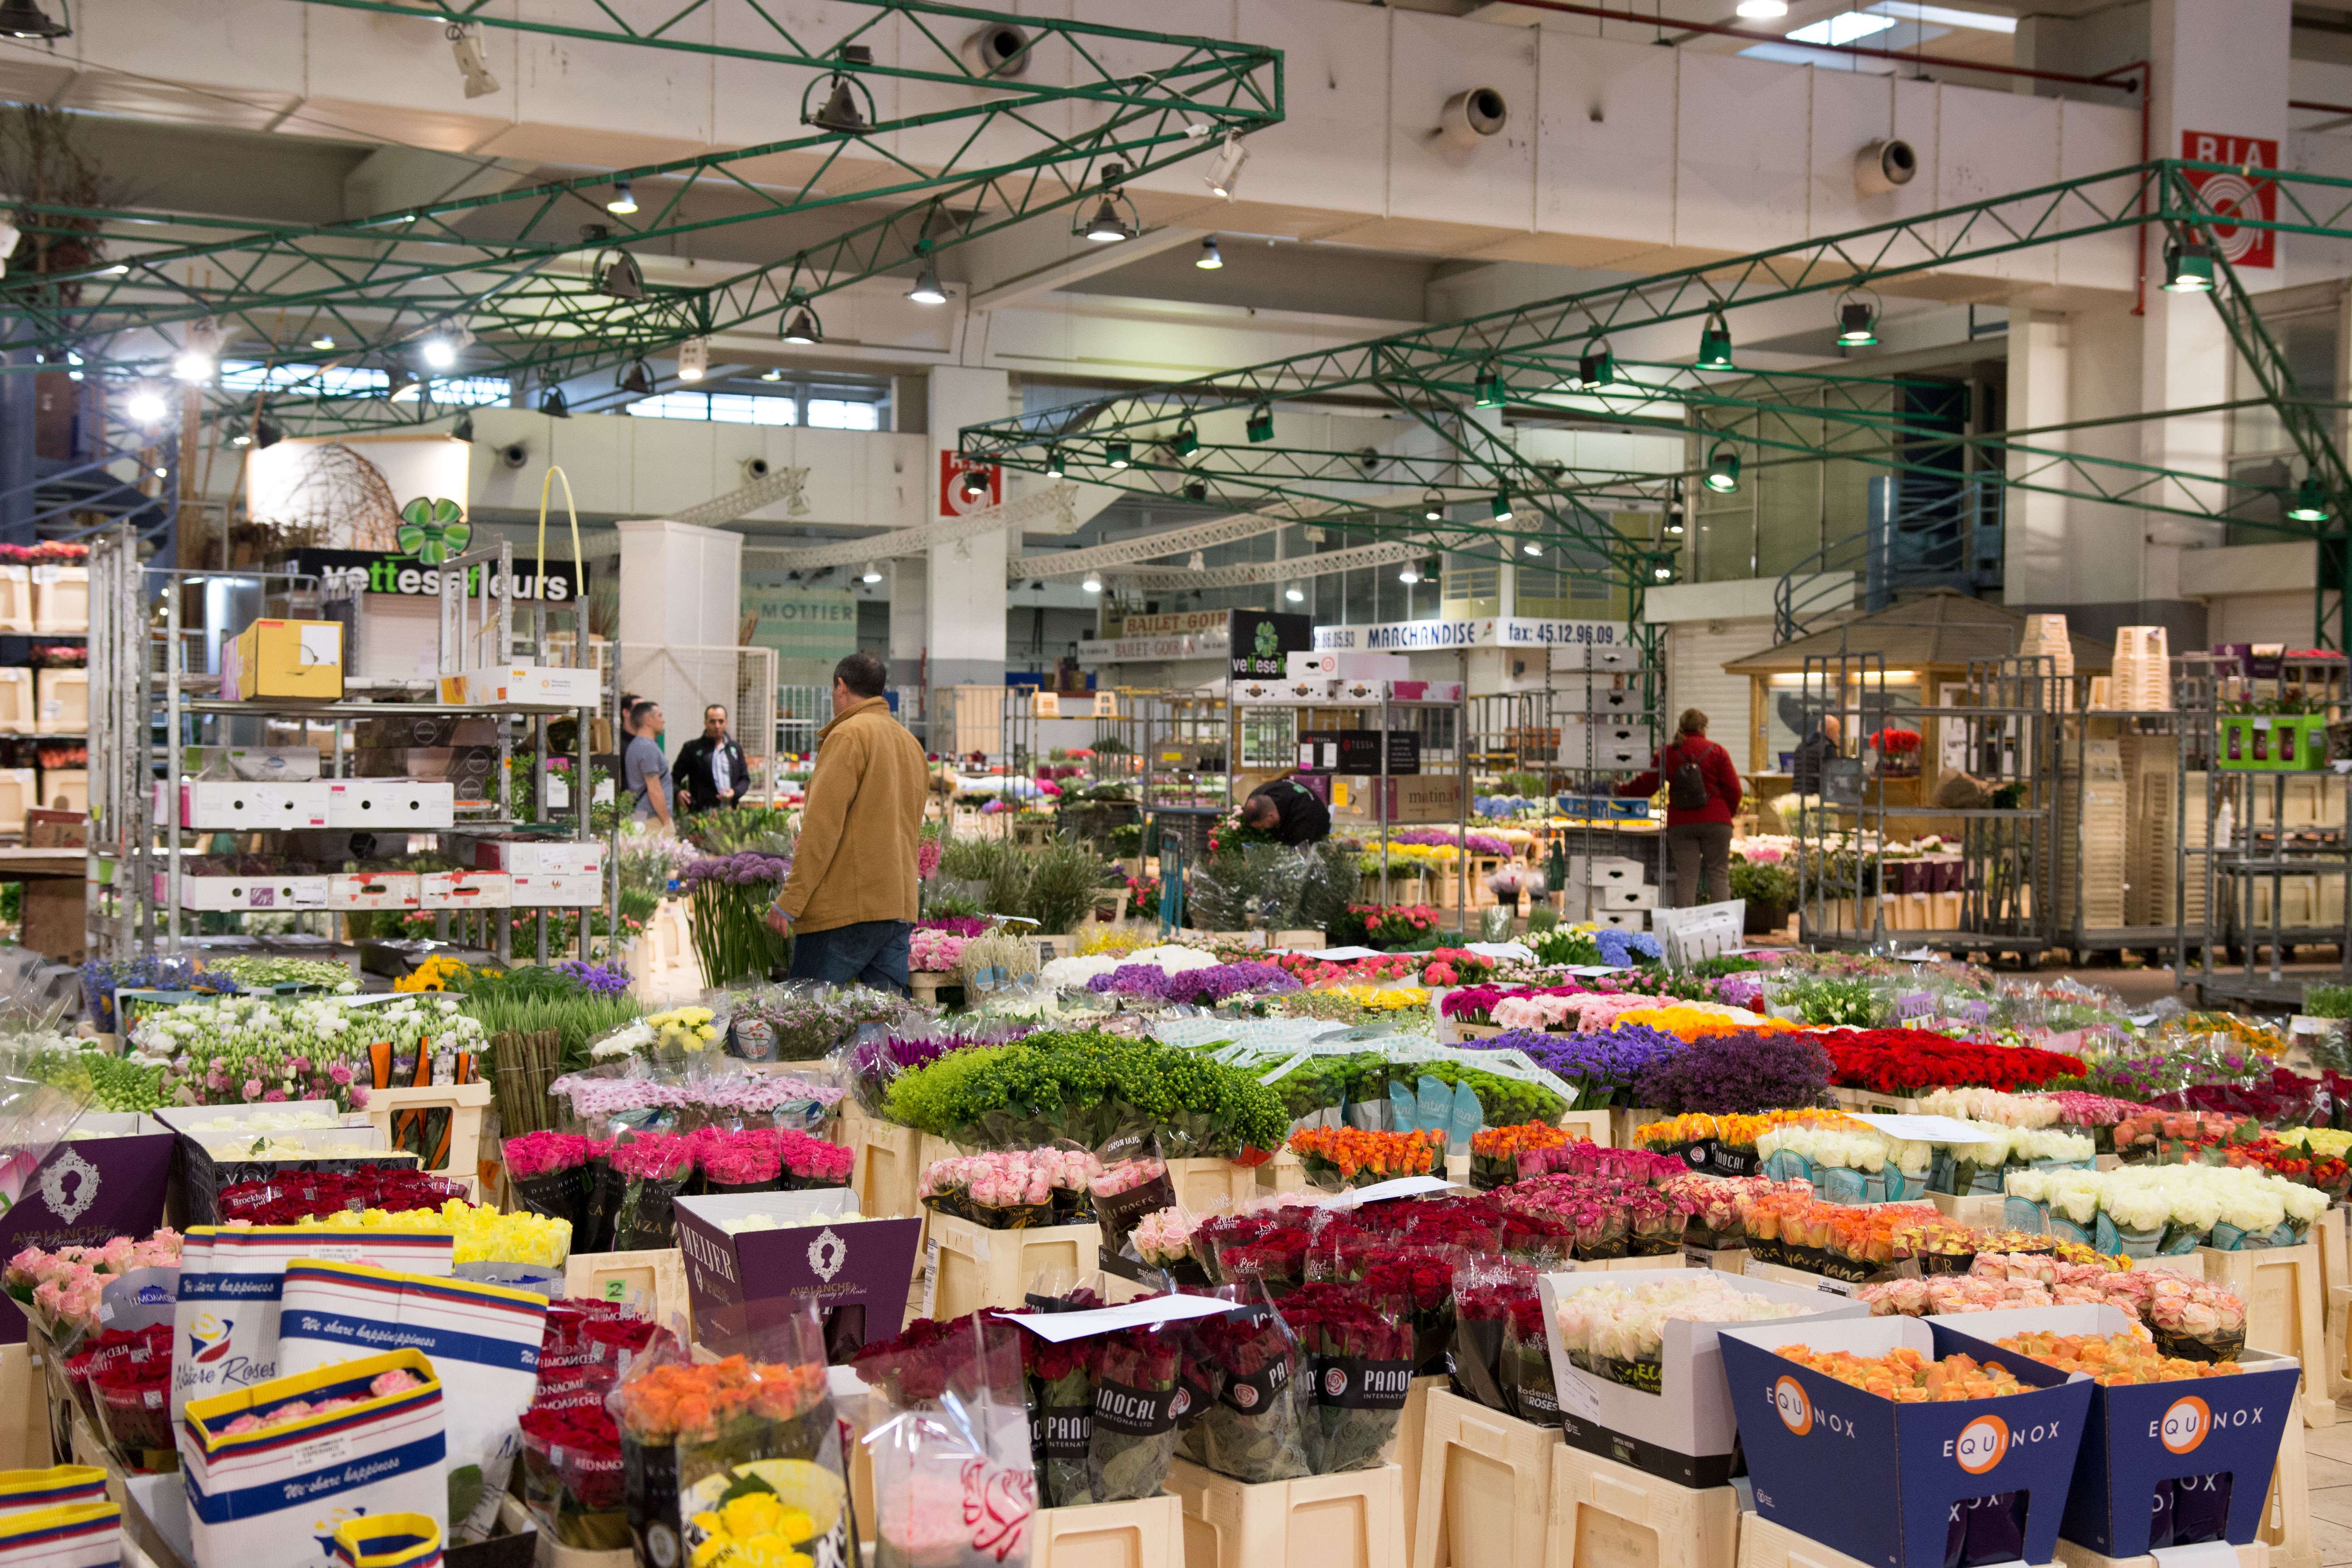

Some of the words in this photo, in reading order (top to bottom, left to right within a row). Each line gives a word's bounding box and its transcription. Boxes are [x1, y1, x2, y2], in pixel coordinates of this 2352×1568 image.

[762, 603, 853, 621] MOTTIER
[1367, 622, 1475, 648] MARCHANDISE
[1509, 622, 1533, 642] fax:
[1538, 623, 1613, 644] 45.12.96.09
[44, 1234, 84, 1248] Beauty
[681, 1222, 736, 1284] MEIJER
[1239, 1256, 1258, 1269] Red
[1137, 1268, 1162, 1284] marjoland
[608, 1283, 623, 1297] 2
[301, 1316, 321, 1331] We
[324, 1320, 355, 1337] share
[218, 1356, 276, 1386] Roses
[1529, 1396, 1558, 1411] ROSES
[1766, 1386, 1856, 1439] EQUINOX
[2149, 1407, 2264, 1438] EQUINOX
[1612, 1436, 1624, 1446] OPEN
[1942, 1421, 2060, 1458] EQUINOX
[309, 1475, 340, 1492] share
[343, 1457, 400, 1483] happiness
